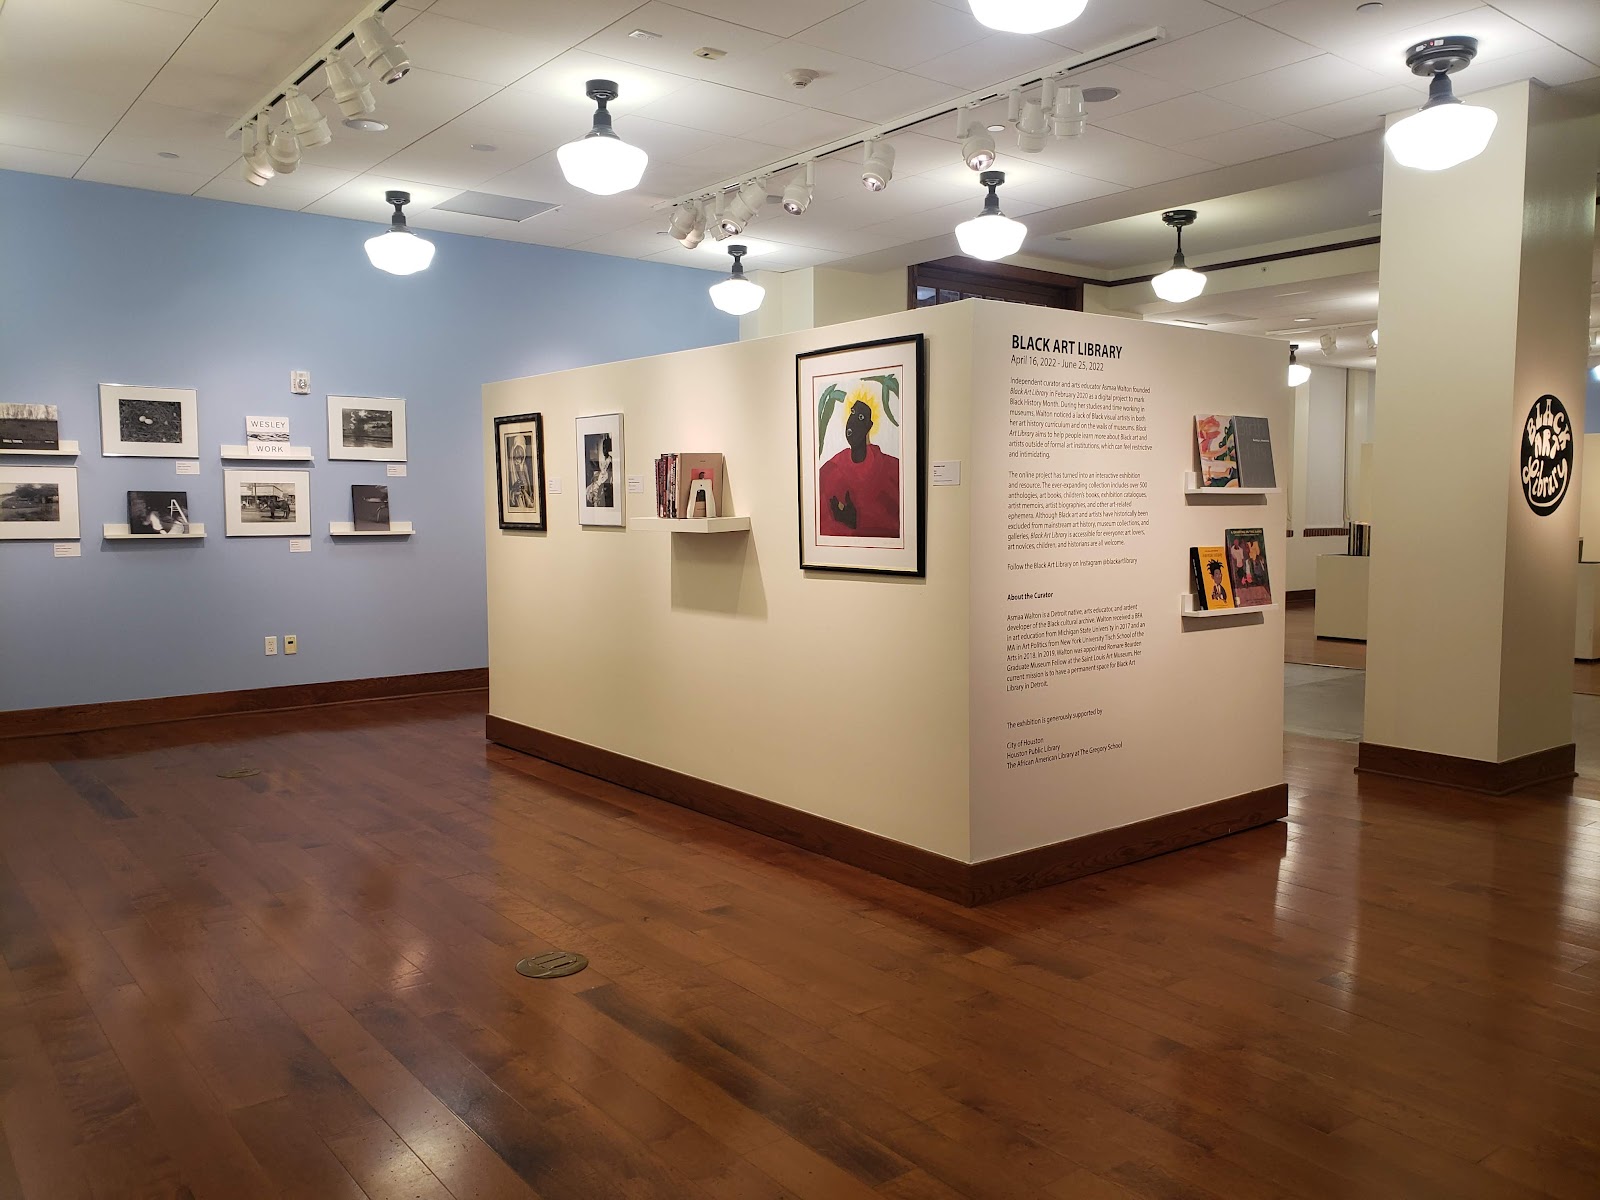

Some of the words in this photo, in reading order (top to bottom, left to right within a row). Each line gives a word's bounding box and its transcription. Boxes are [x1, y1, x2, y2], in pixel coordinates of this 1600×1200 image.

[1012, 335, 1050, 352] BLACK
[1053, 340, 1075, 354] ART
[1078, 342, 1122, 358] LIBRARY
[1011, 354, 1027, 366] April
[1029, 356, 1038, 367] 16,
[1040, 357, 1056, 367] 2022
[1062, 360, 1077, 369] June
[1078, 360, 1088, 371] 25,
[1089, 362, 1104, 371] 2022
[250, 420, 286, 429] WESLEY
[1527, 399, 1570, 451] BLACK
[1534, 429, 1560, 459] ART
[1017, 719, 1041, 727] exhibition
[1047, 713, 1072, 724] generously
[1073, 709, 1096, 719] supported
[1007, 742, 1016, 750] City
[1024, 738, 1043, 746] Houston
[1007, 751, 1028, 759] Houston
[1029, 747, 1043, 755] Public
[1035, 755, 1058, 764] American
[1058, 752, 1074, 760] Library
[1089, 746, 1107, 754] Gregory
[1108, 741, 1122, 750] School
